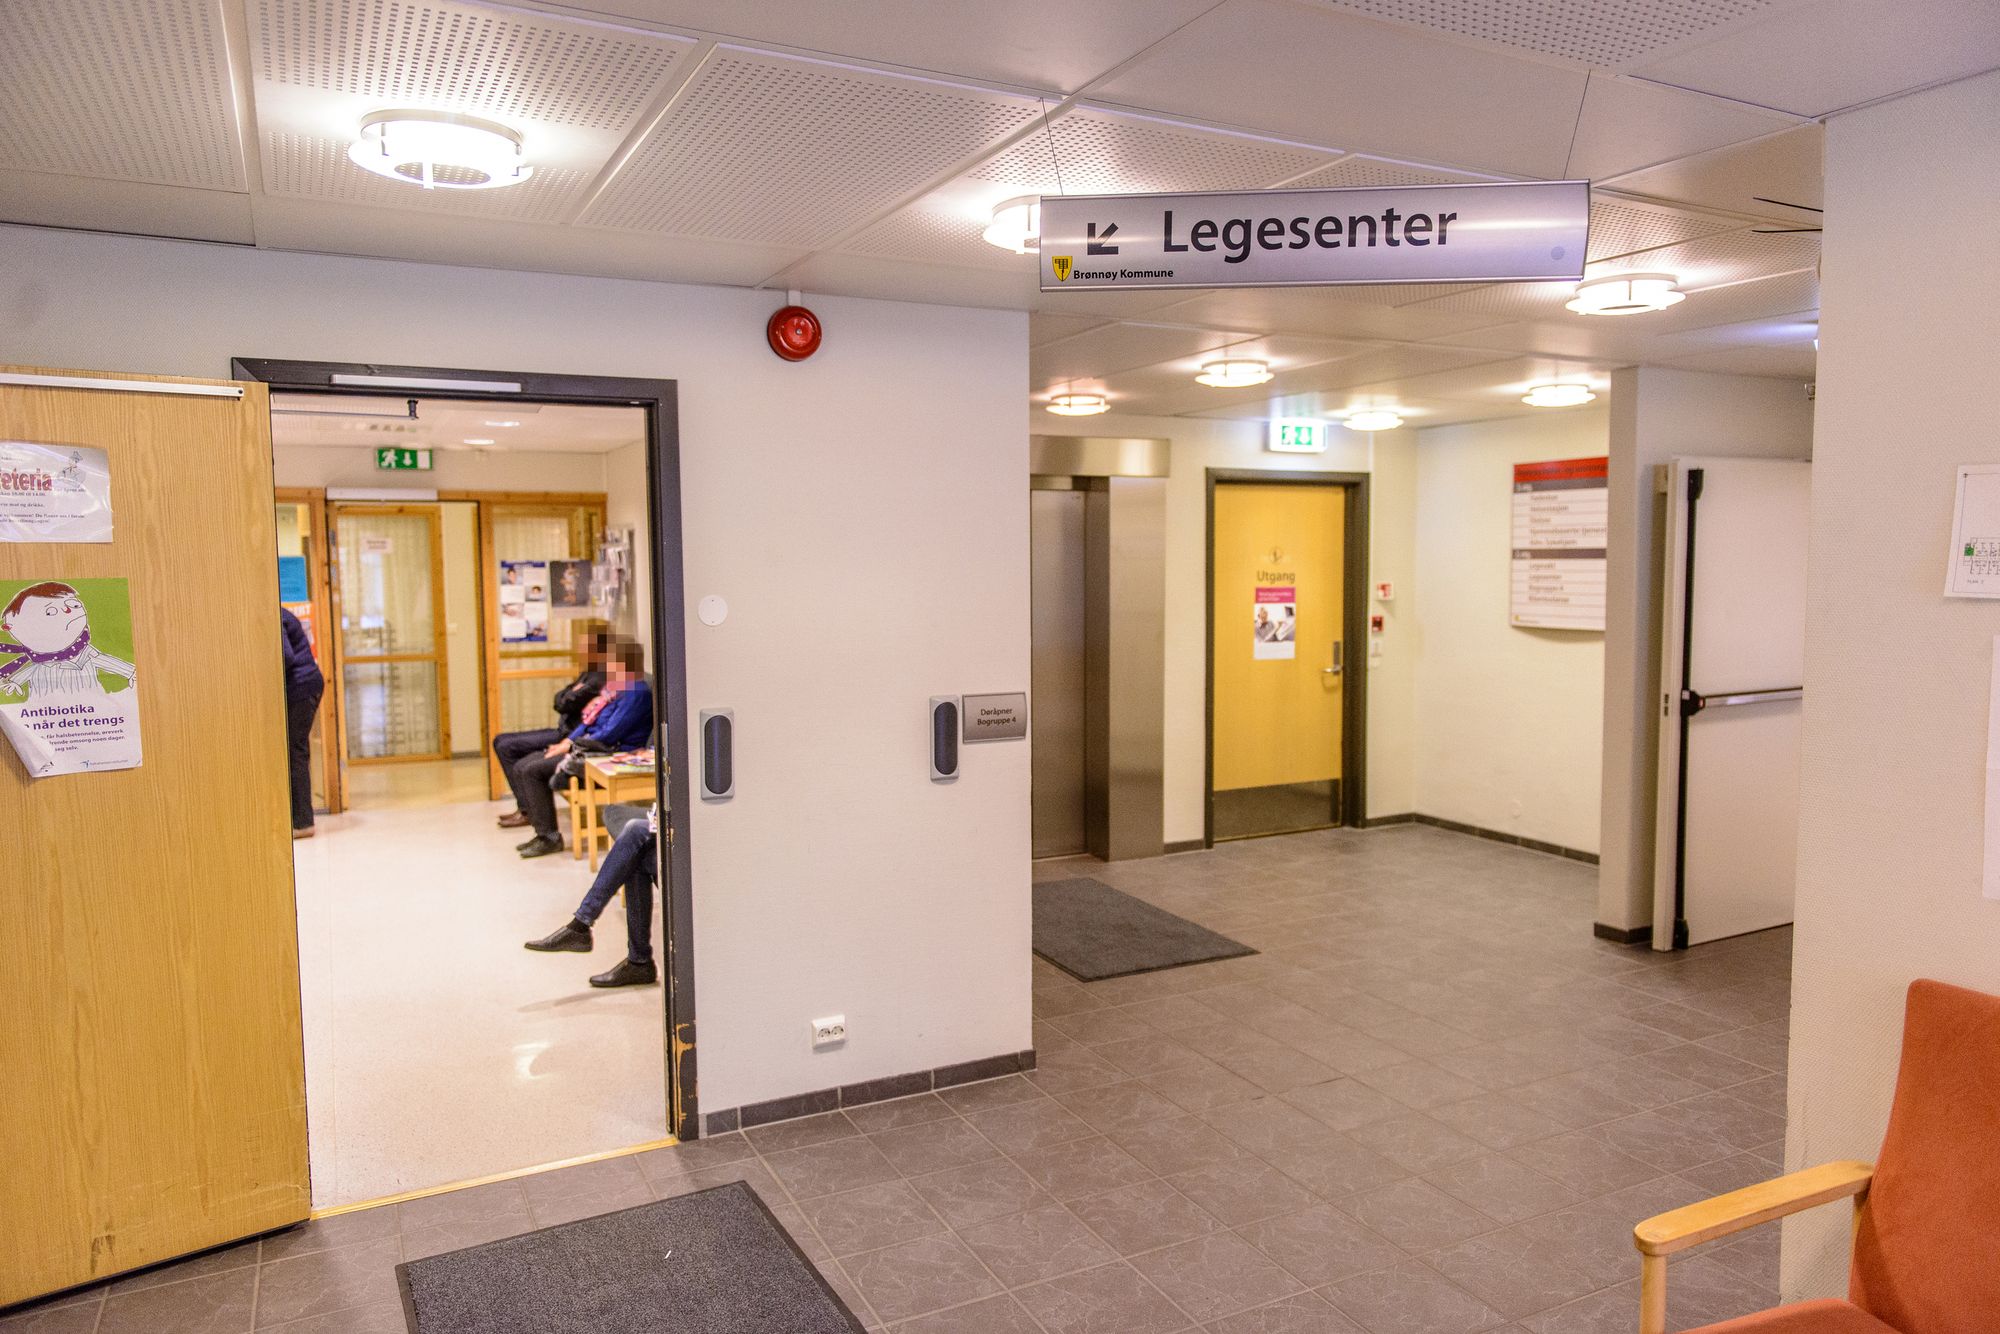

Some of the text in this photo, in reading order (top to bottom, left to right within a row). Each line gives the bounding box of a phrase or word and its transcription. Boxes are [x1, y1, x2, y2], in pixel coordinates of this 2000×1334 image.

[1163, 207, 1457, 263] Legesenter
[1073, 269, 1174, 281] Brønnøy Kommune
[0, 467, 52, 491] eteria
[1257, 570, 1295, 584] Utgang
[20, 704, 95, 718] Antibiotika
[981, 708, 1012, 716] Døråpner
[33, 719, 55, 730] når
[58, 718, 80, 728] det
[83, 715, 125, 727] trengs
[977, 718, 1010, 726] Bogruppe
